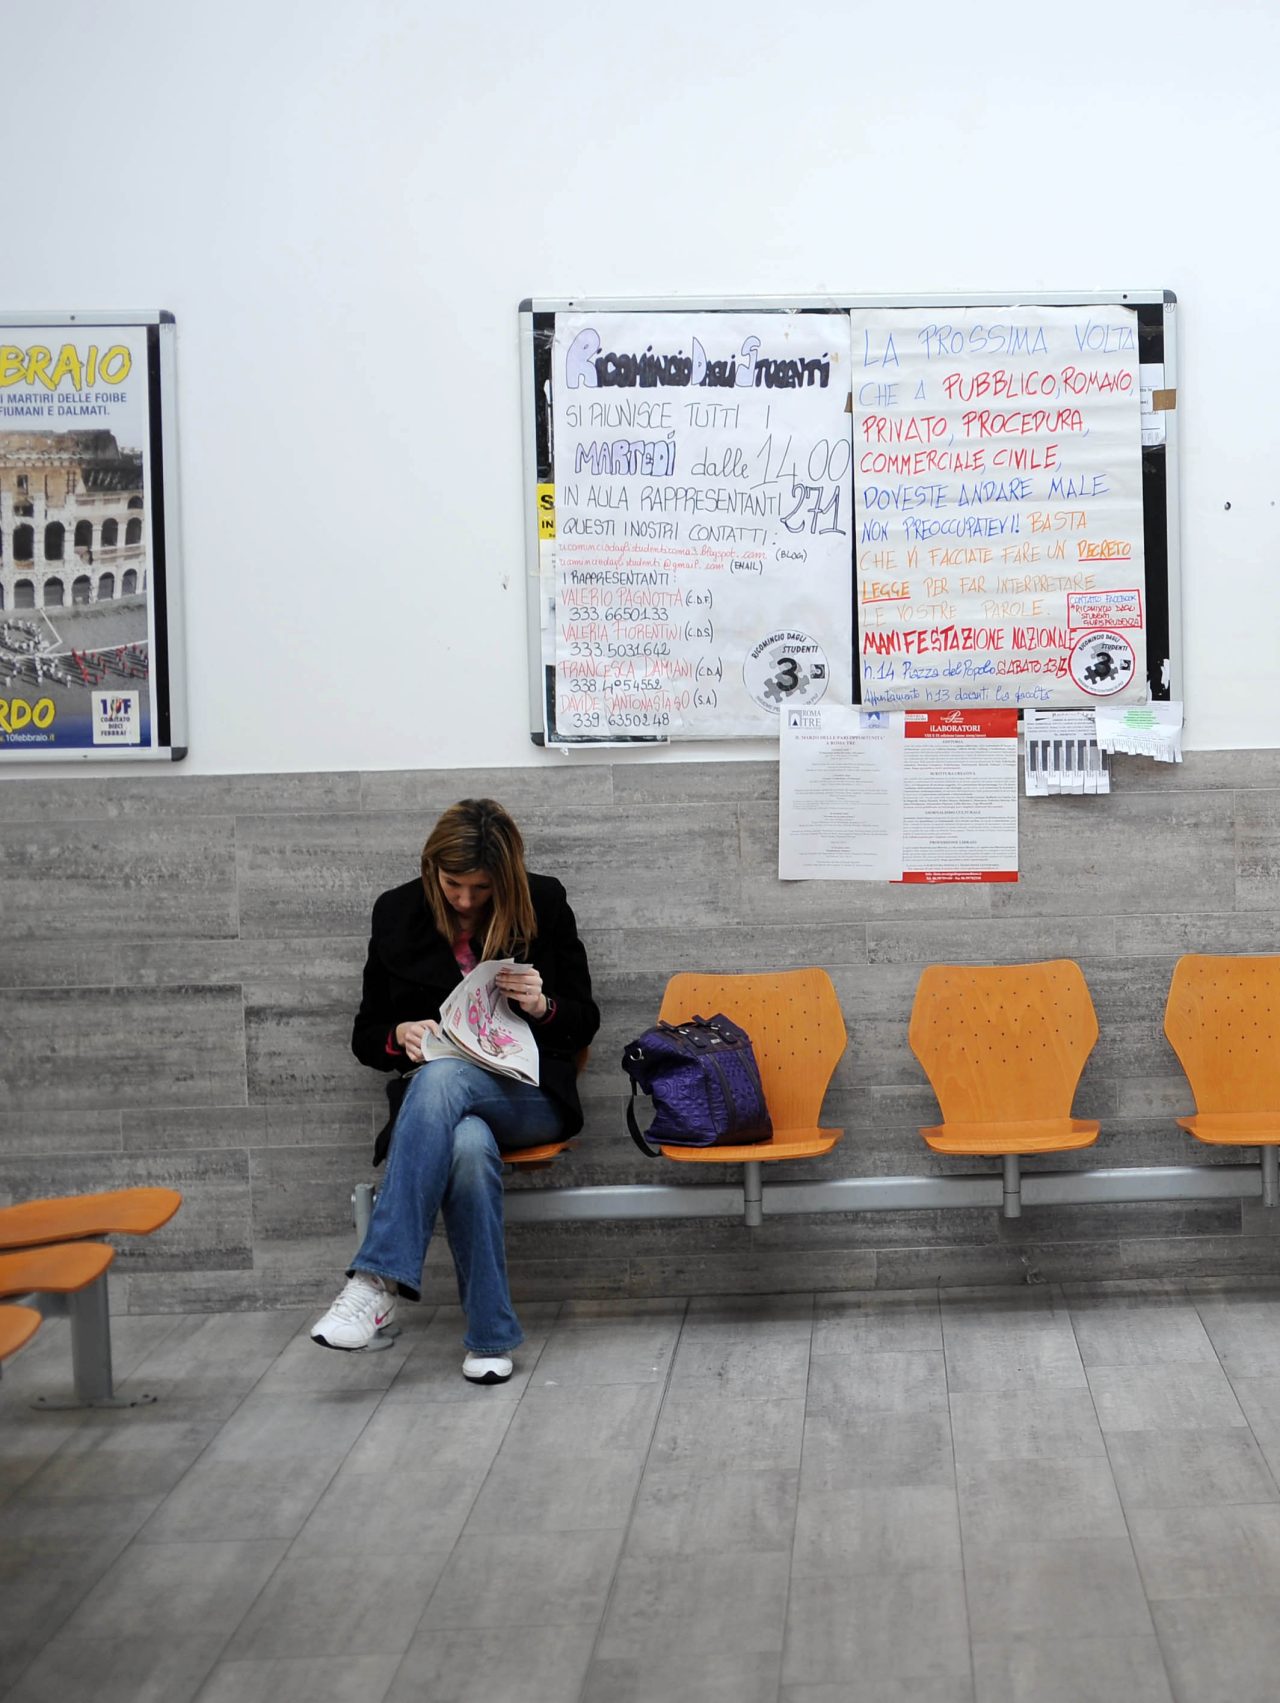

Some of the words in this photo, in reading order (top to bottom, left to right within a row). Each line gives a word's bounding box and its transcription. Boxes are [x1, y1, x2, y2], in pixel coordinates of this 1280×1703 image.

[863, 328, 900, 369] LA
[918, 323, 1049, 361] PROSSIMA
[1074, 319, 1137, 355] VOLTA
[7, 393, 54, 403] MARTIRI
[58, 393, 91, 402] DELLE
[95, 393, 126, 402] FOIBE
[859, 382, 900, 407] CHE
[48, 406, 53, 415] E
[58, 406, 110, 415] DALMATI.
[566, 404, 582, 428] SI
[590, 399, 672, 429] RIUNISCE
[685, 403, 740, 429] TUTTI
[691, 447, 750, 478] dalle
[564, 486, 579, 507] IN
[587, 486, 629, 511] AULA
[641, 486, 782, 516] RAPPRESENTANTI
[863, 483, 950, 512] DOVESTE
[958, 477, 1033, 507] ANDARE
[1048, 474, 1111, 500] MALE
[563, 518, 615, 536] QUESTI
[630, 520, 678, 540] NOSTRI
[861, 520, 889, 544] NON
[1027, 511, 1088, 533] BASTA
[860, 550, 898, 571] CHE
[928, 546, 994, 568] FACCIATE
[1002, 542, 1040, 565] FARE
[1046, 539, 1067, 560] UN
[1077, 539, 1131, 558] DECRETO
[561, 587, 612, 607] VALERIO
[616, 586, 683, 607] PAGNOTTA
[862, 580, 910, 600] LEGGE
[923, 576, 949, 598] PER
[960, 575, 987, 595] FAR
[897, 598, 957, 622] VOSTRE
[562, 622, 608, 643] VALERIA
[613, 620, 682, 641] FIORENTINI
[862, 624, 1005, 655] MANIFESTAZIONE
[751, 633, 785, 659] RICOMINCIO
[787, 632, 807, 643] DAGLI
[782, 645, 819, 654] STUDENTI
[559, 655, 636, 679] FRANCESCA
[644, 655, 693, 680] DAMIANI
[777, 657, 799, 692] 3
[902, 660, 939, 680] Piazza
[561, 691, 600, 714] DAVIDE
[804, 718, 821, 726] TRE
